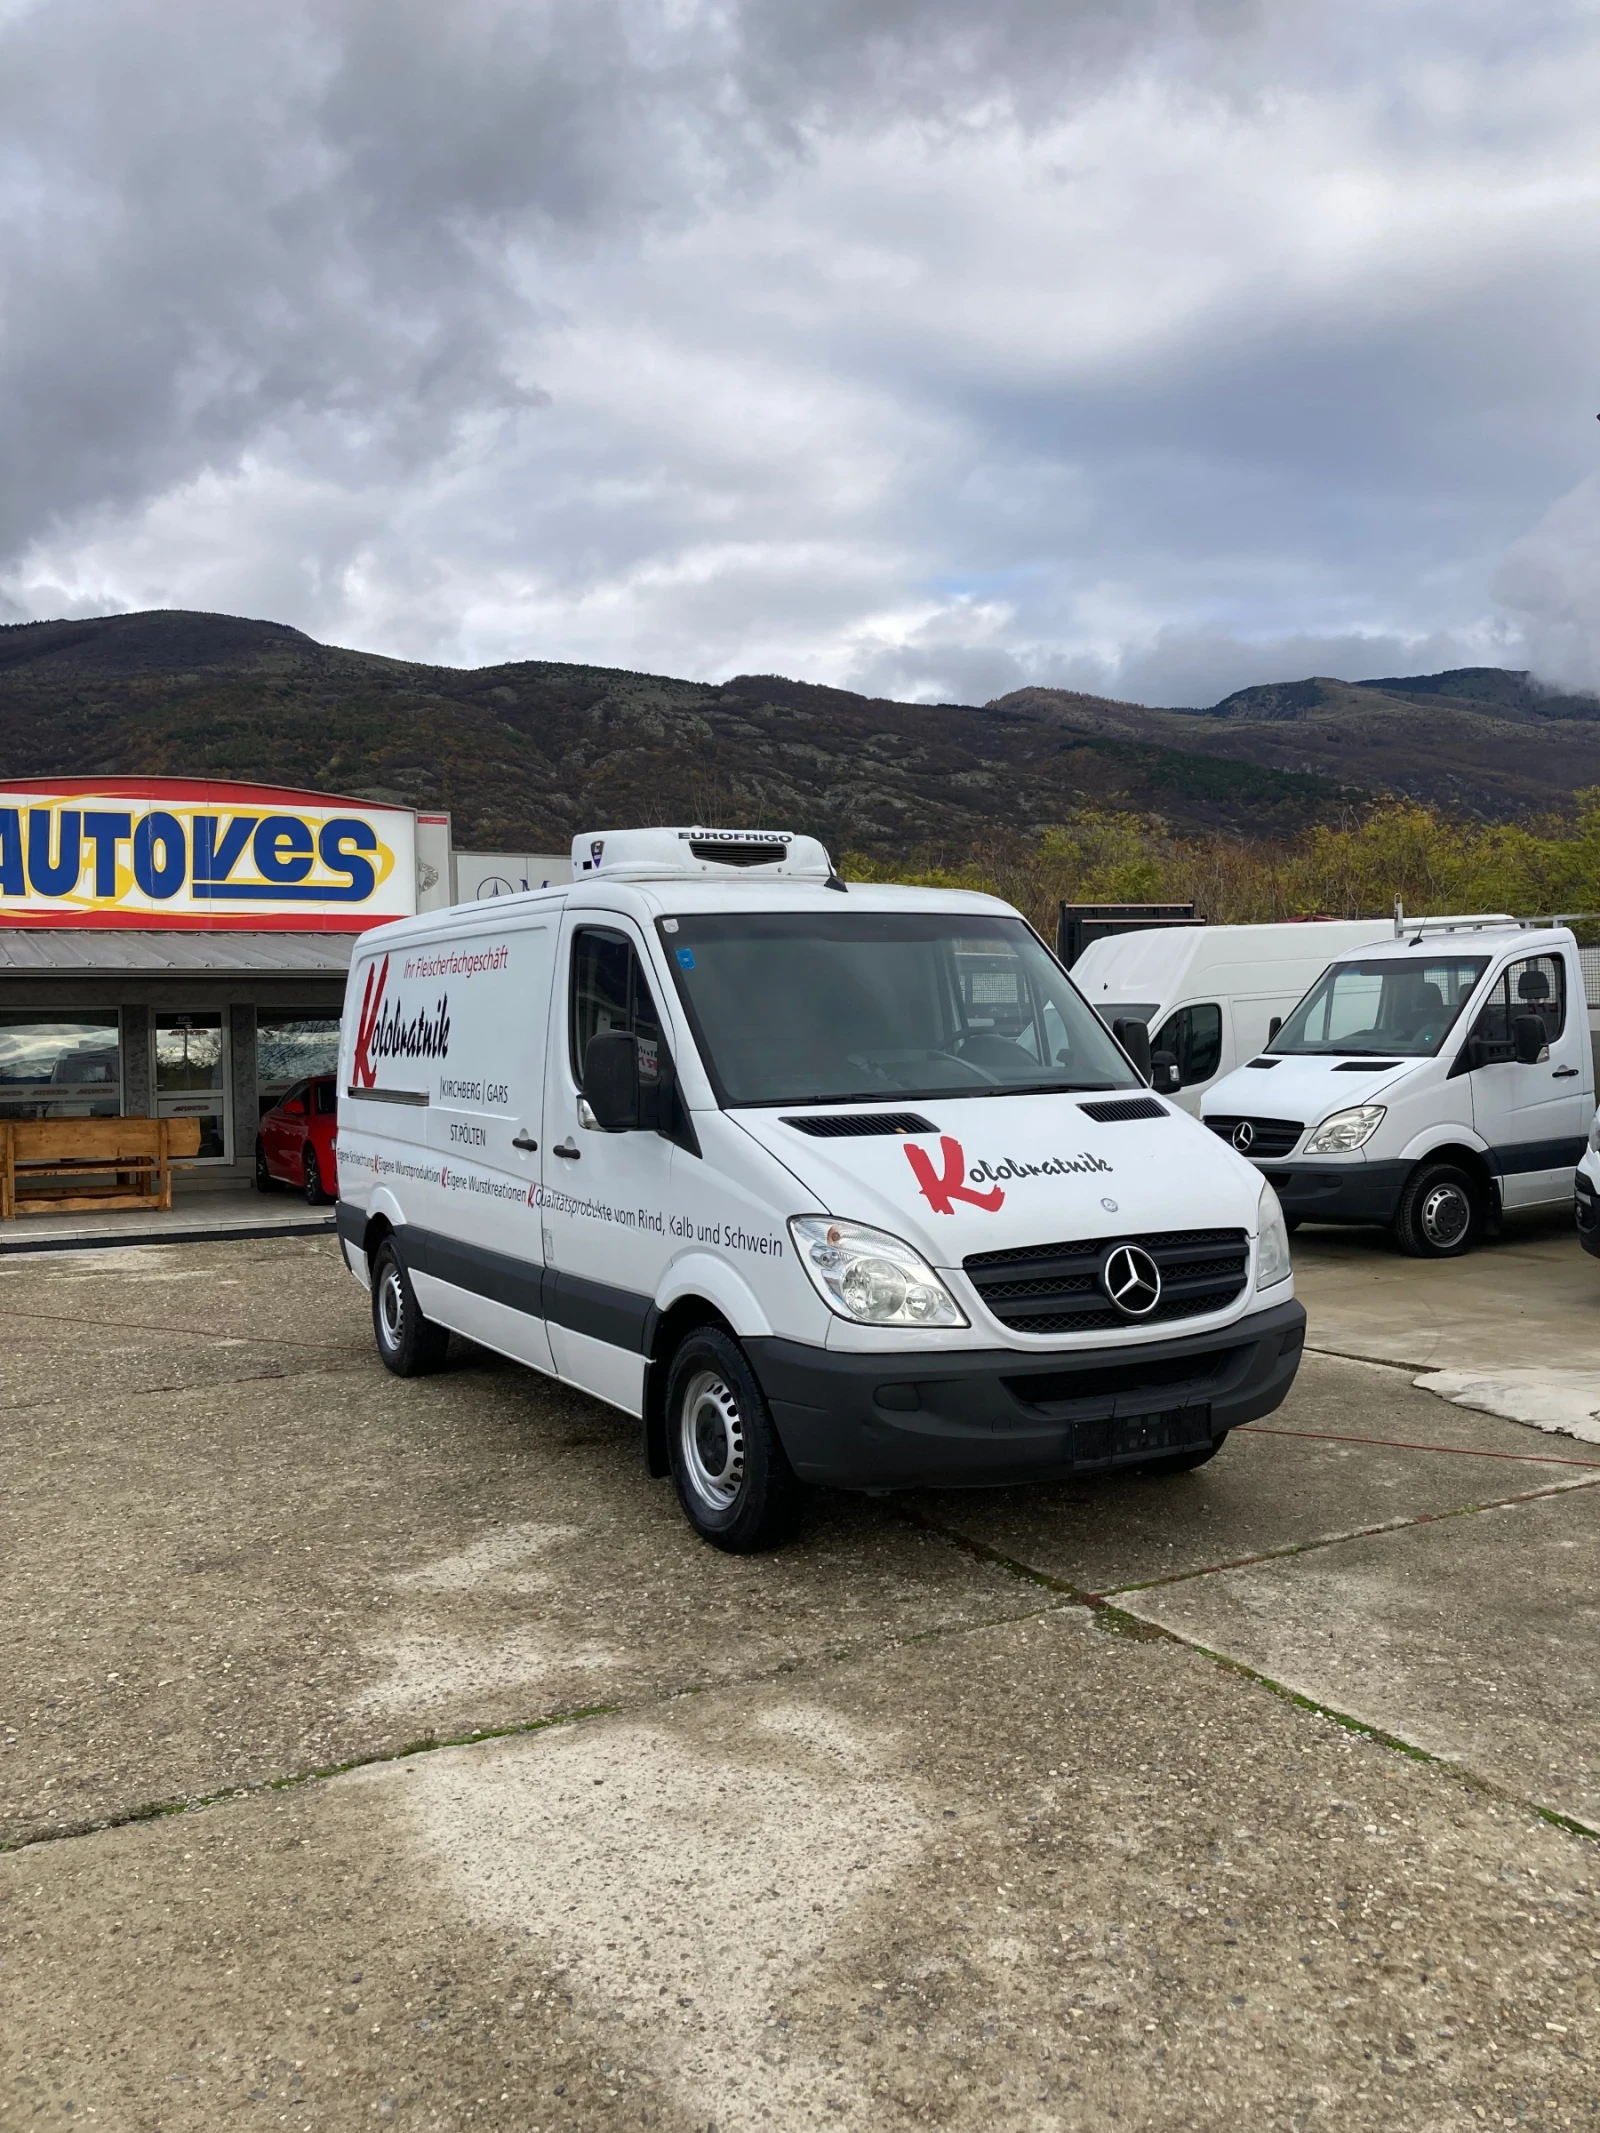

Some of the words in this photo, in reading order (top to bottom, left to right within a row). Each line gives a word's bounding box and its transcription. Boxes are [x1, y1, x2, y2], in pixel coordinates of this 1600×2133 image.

[678, 832, 793, 843] EUROFRIGO
[404, 958, 416, 979] Ihr
[416, 945, 509, 978] Fleischerfachgeschäft
[352, 952, 451, 1088] Kolobratnik
[487, 1084, 508, 1104] GARS
[903, 1136, 1113, 1215] Kolobratnik
[350, 1151, 374, 1172] Schlachtung
[379, 1156, 395, 1175] Eigene
[395, 1160, 441, 1184] Wurstproduktion
[447, 1171, 467, 1191] Eigene
[468, 1176, 526, 1202] Wurstkreationen
[535, 1188, 613, 1222] Qualitätsprodukte
[614, 1212, 636, 1227] vom
[638, 1209, 666, 1236] Rind,
[669, 1214, 694, 1239] Kalb
[697, 1223, 720, 1245] und
[724, 1225, 783, 1258] Schwein
